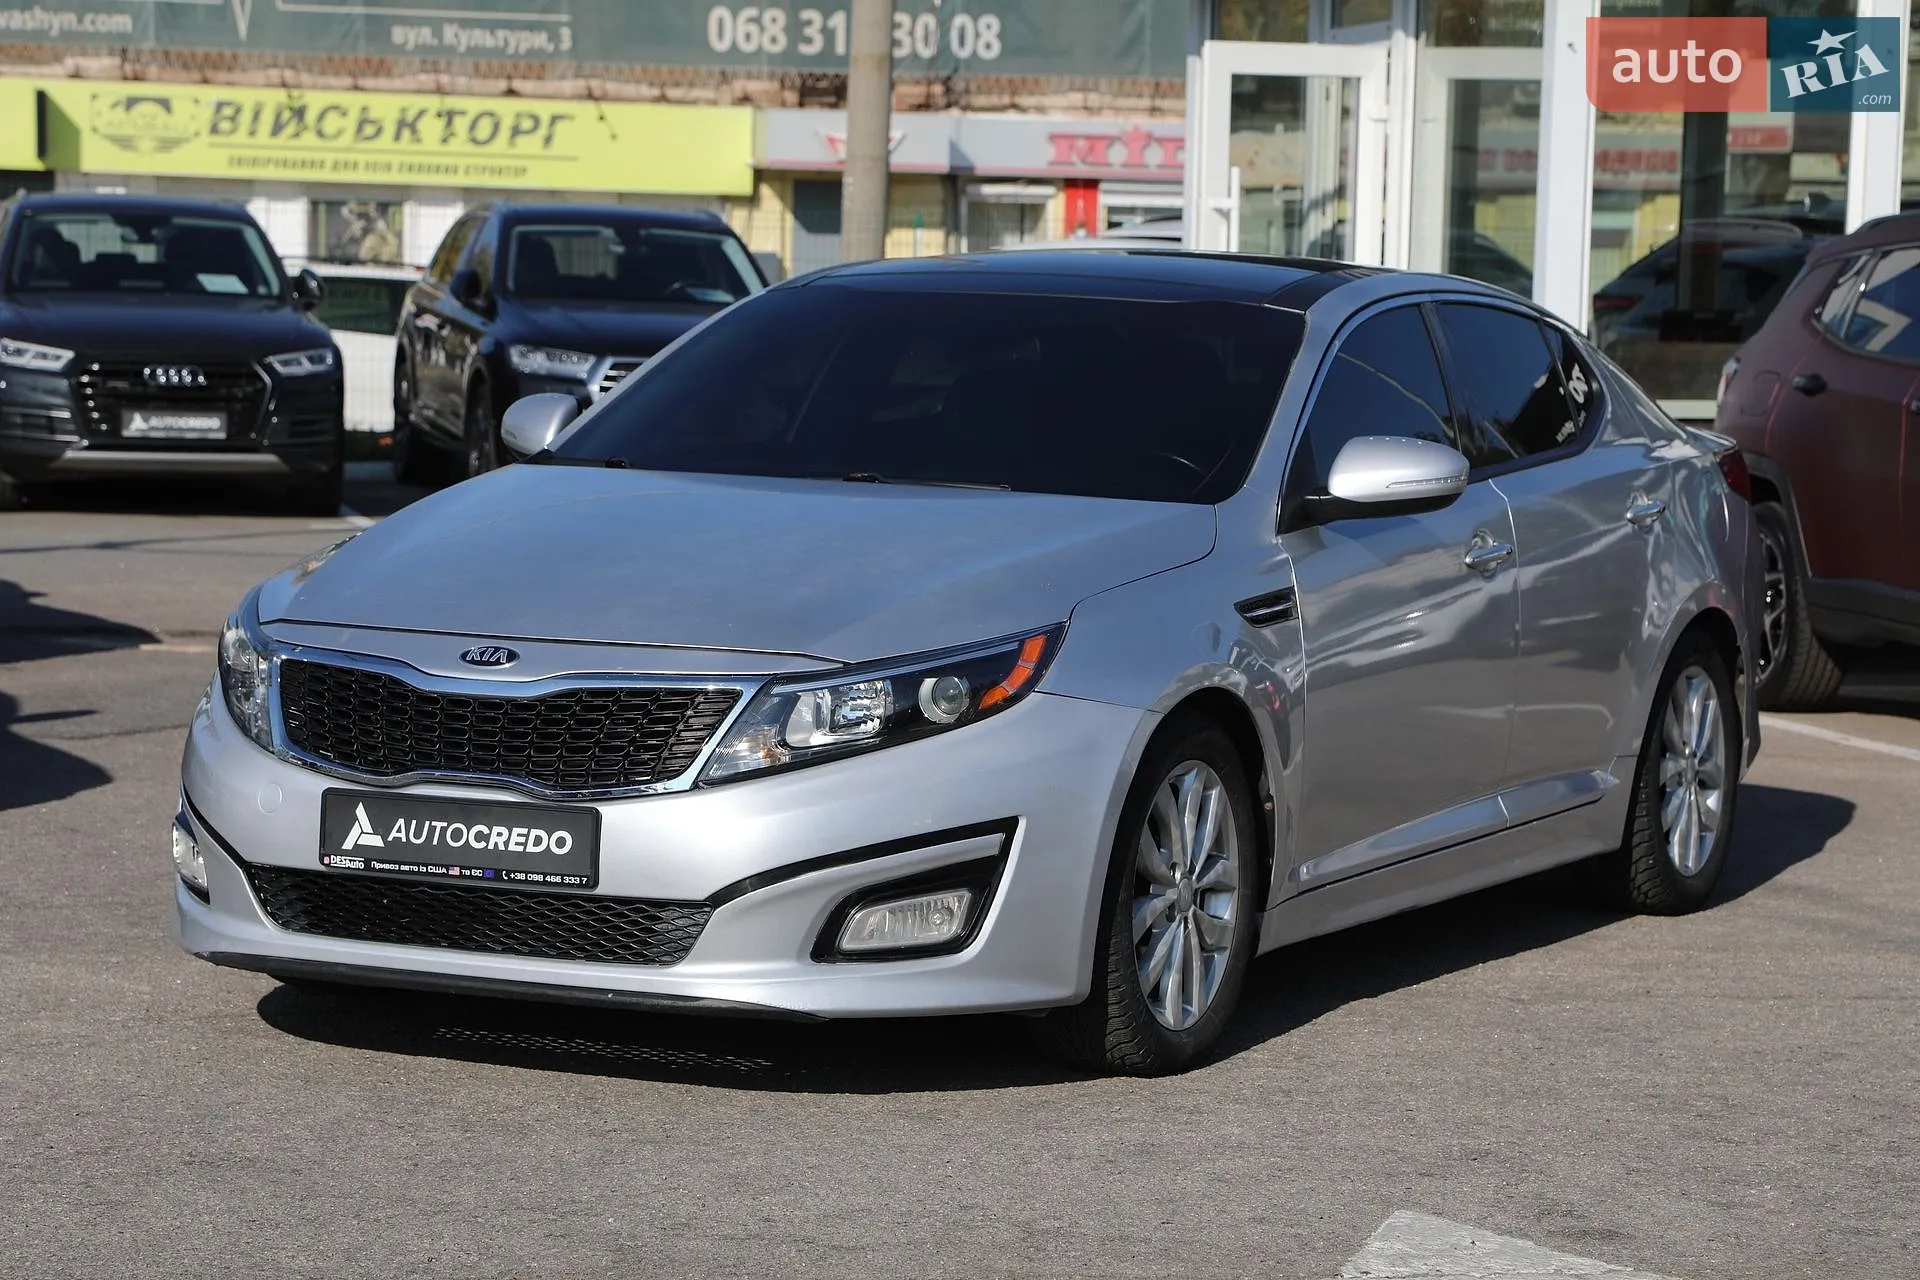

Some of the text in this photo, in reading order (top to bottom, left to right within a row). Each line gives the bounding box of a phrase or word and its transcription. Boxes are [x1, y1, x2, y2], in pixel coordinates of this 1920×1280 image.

[557, 26, 573, 51] 3
[706, 6, 787, 54] 068
[892, 11, 940, 59] 30
[950, 12, 1001, 61] 08
[208, 98, 574, 149] ВІЙСЬКТОРГ
[466, 646, 508, 663] KIA
[387, 818, 573, 855] AUTOCREDO
[371, 861, 399, 871] Привоз
[400, 864, 418, 872] авто
[428, 866, 447, 874] США
[509, 872, 526, 880] +38
[527, 874, 544, 882] 098
[563, 876, 580, 885] 333
[581, 877, 588, 885] 7
